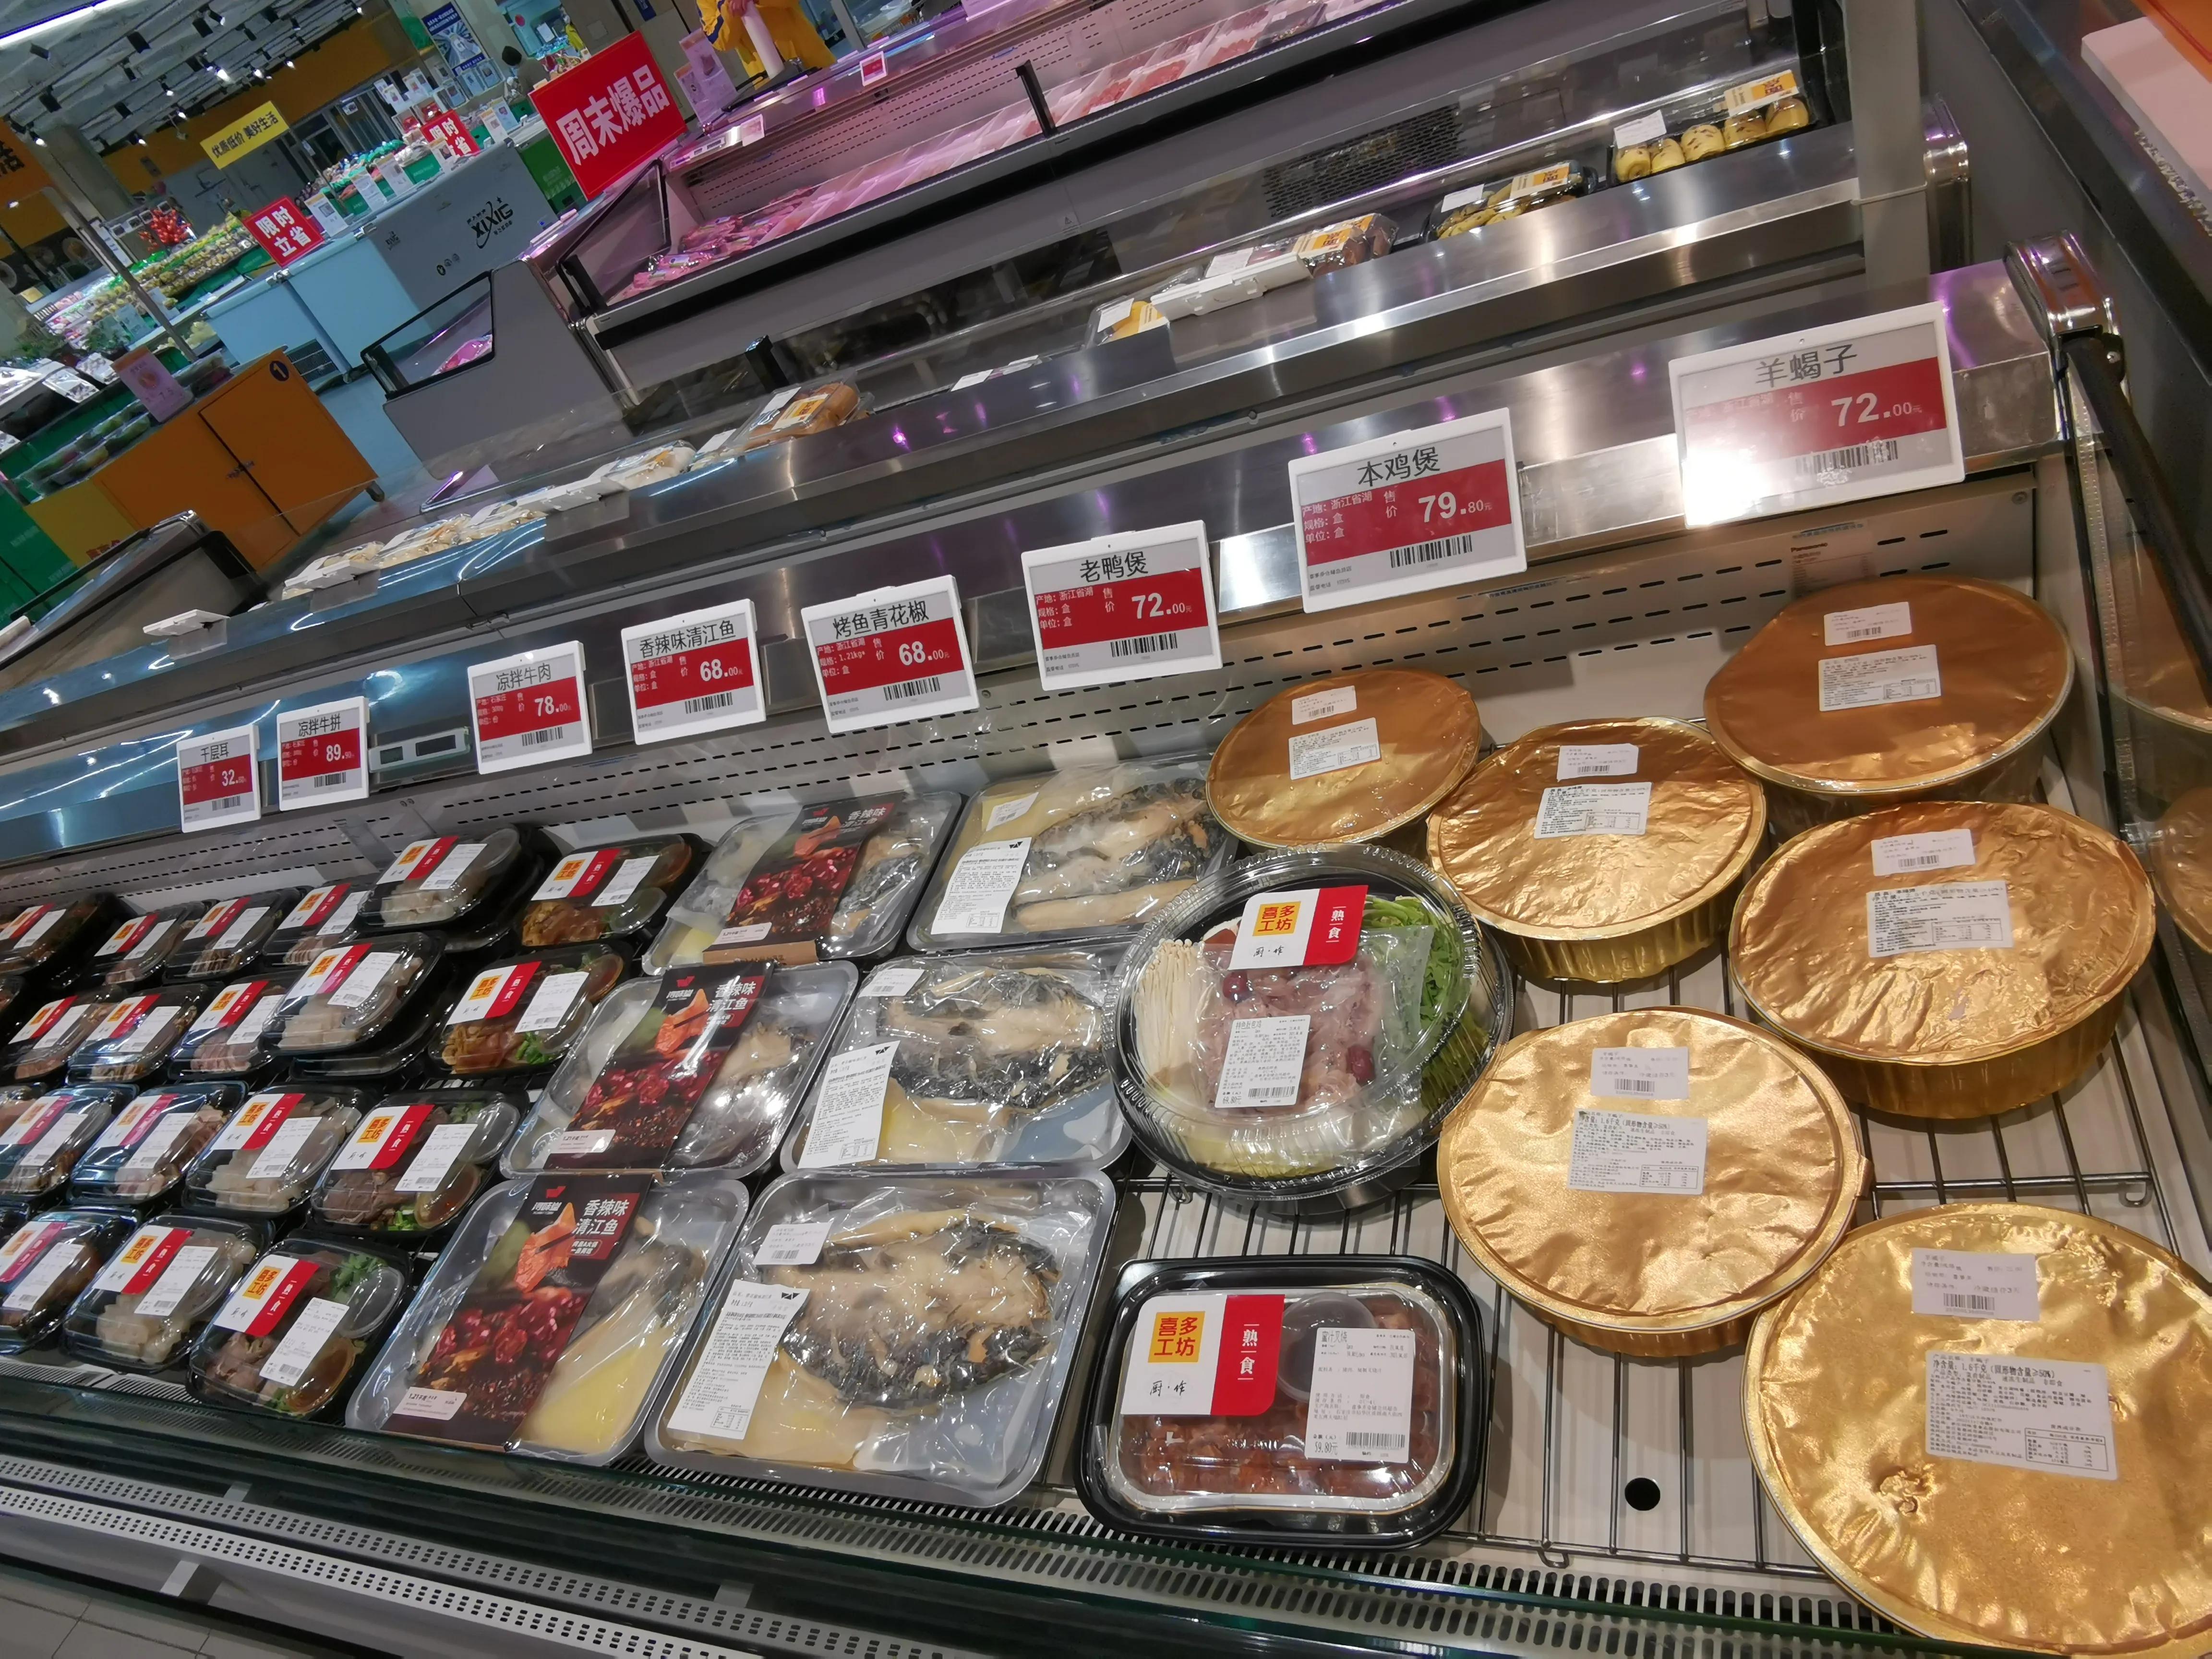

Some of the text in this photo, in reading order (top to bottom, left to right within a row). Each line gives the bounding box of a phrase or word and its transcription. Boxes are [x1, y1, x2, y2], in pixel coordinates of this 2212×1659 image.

[556, 64, 671, 166] 周末爆品
[212, 111, 278, 158] 优质低价 美好生活
[255, 206, 295, 239] 限时
[274, 226, 311, 257] 立省
[1756, 344, 1857, 387] 羊蝎子
[1357, 446, 1441, 487] 本鸡煲
[1080, 551, 1149, 582] 老鸭煲
[833, 600, 929, 639] 烤鱼青花椒
[639, 620, 736, 659] 香辣味清江鱼
[496, 663, 551, 691] 凉拌牛肉
[298, 713, 341, 737] 凉拌牛拼
[200, 742, 229, 762] 千层耳
[1258, 918, 1293, 932] 工坊
[1262, 905, 1295, 919] 喜多
[1328, 909, 1345, 939] 熟食
[583, 1199, 630, 1216] 香辣味
[571, 1218, 619, 1235] 清江鱼
[1159, 1316, 1199, 1336] 喜多
[1154, 1337, 1196, 1357] 工坊
[1240, 1328, 1258, 1374] 熟食
